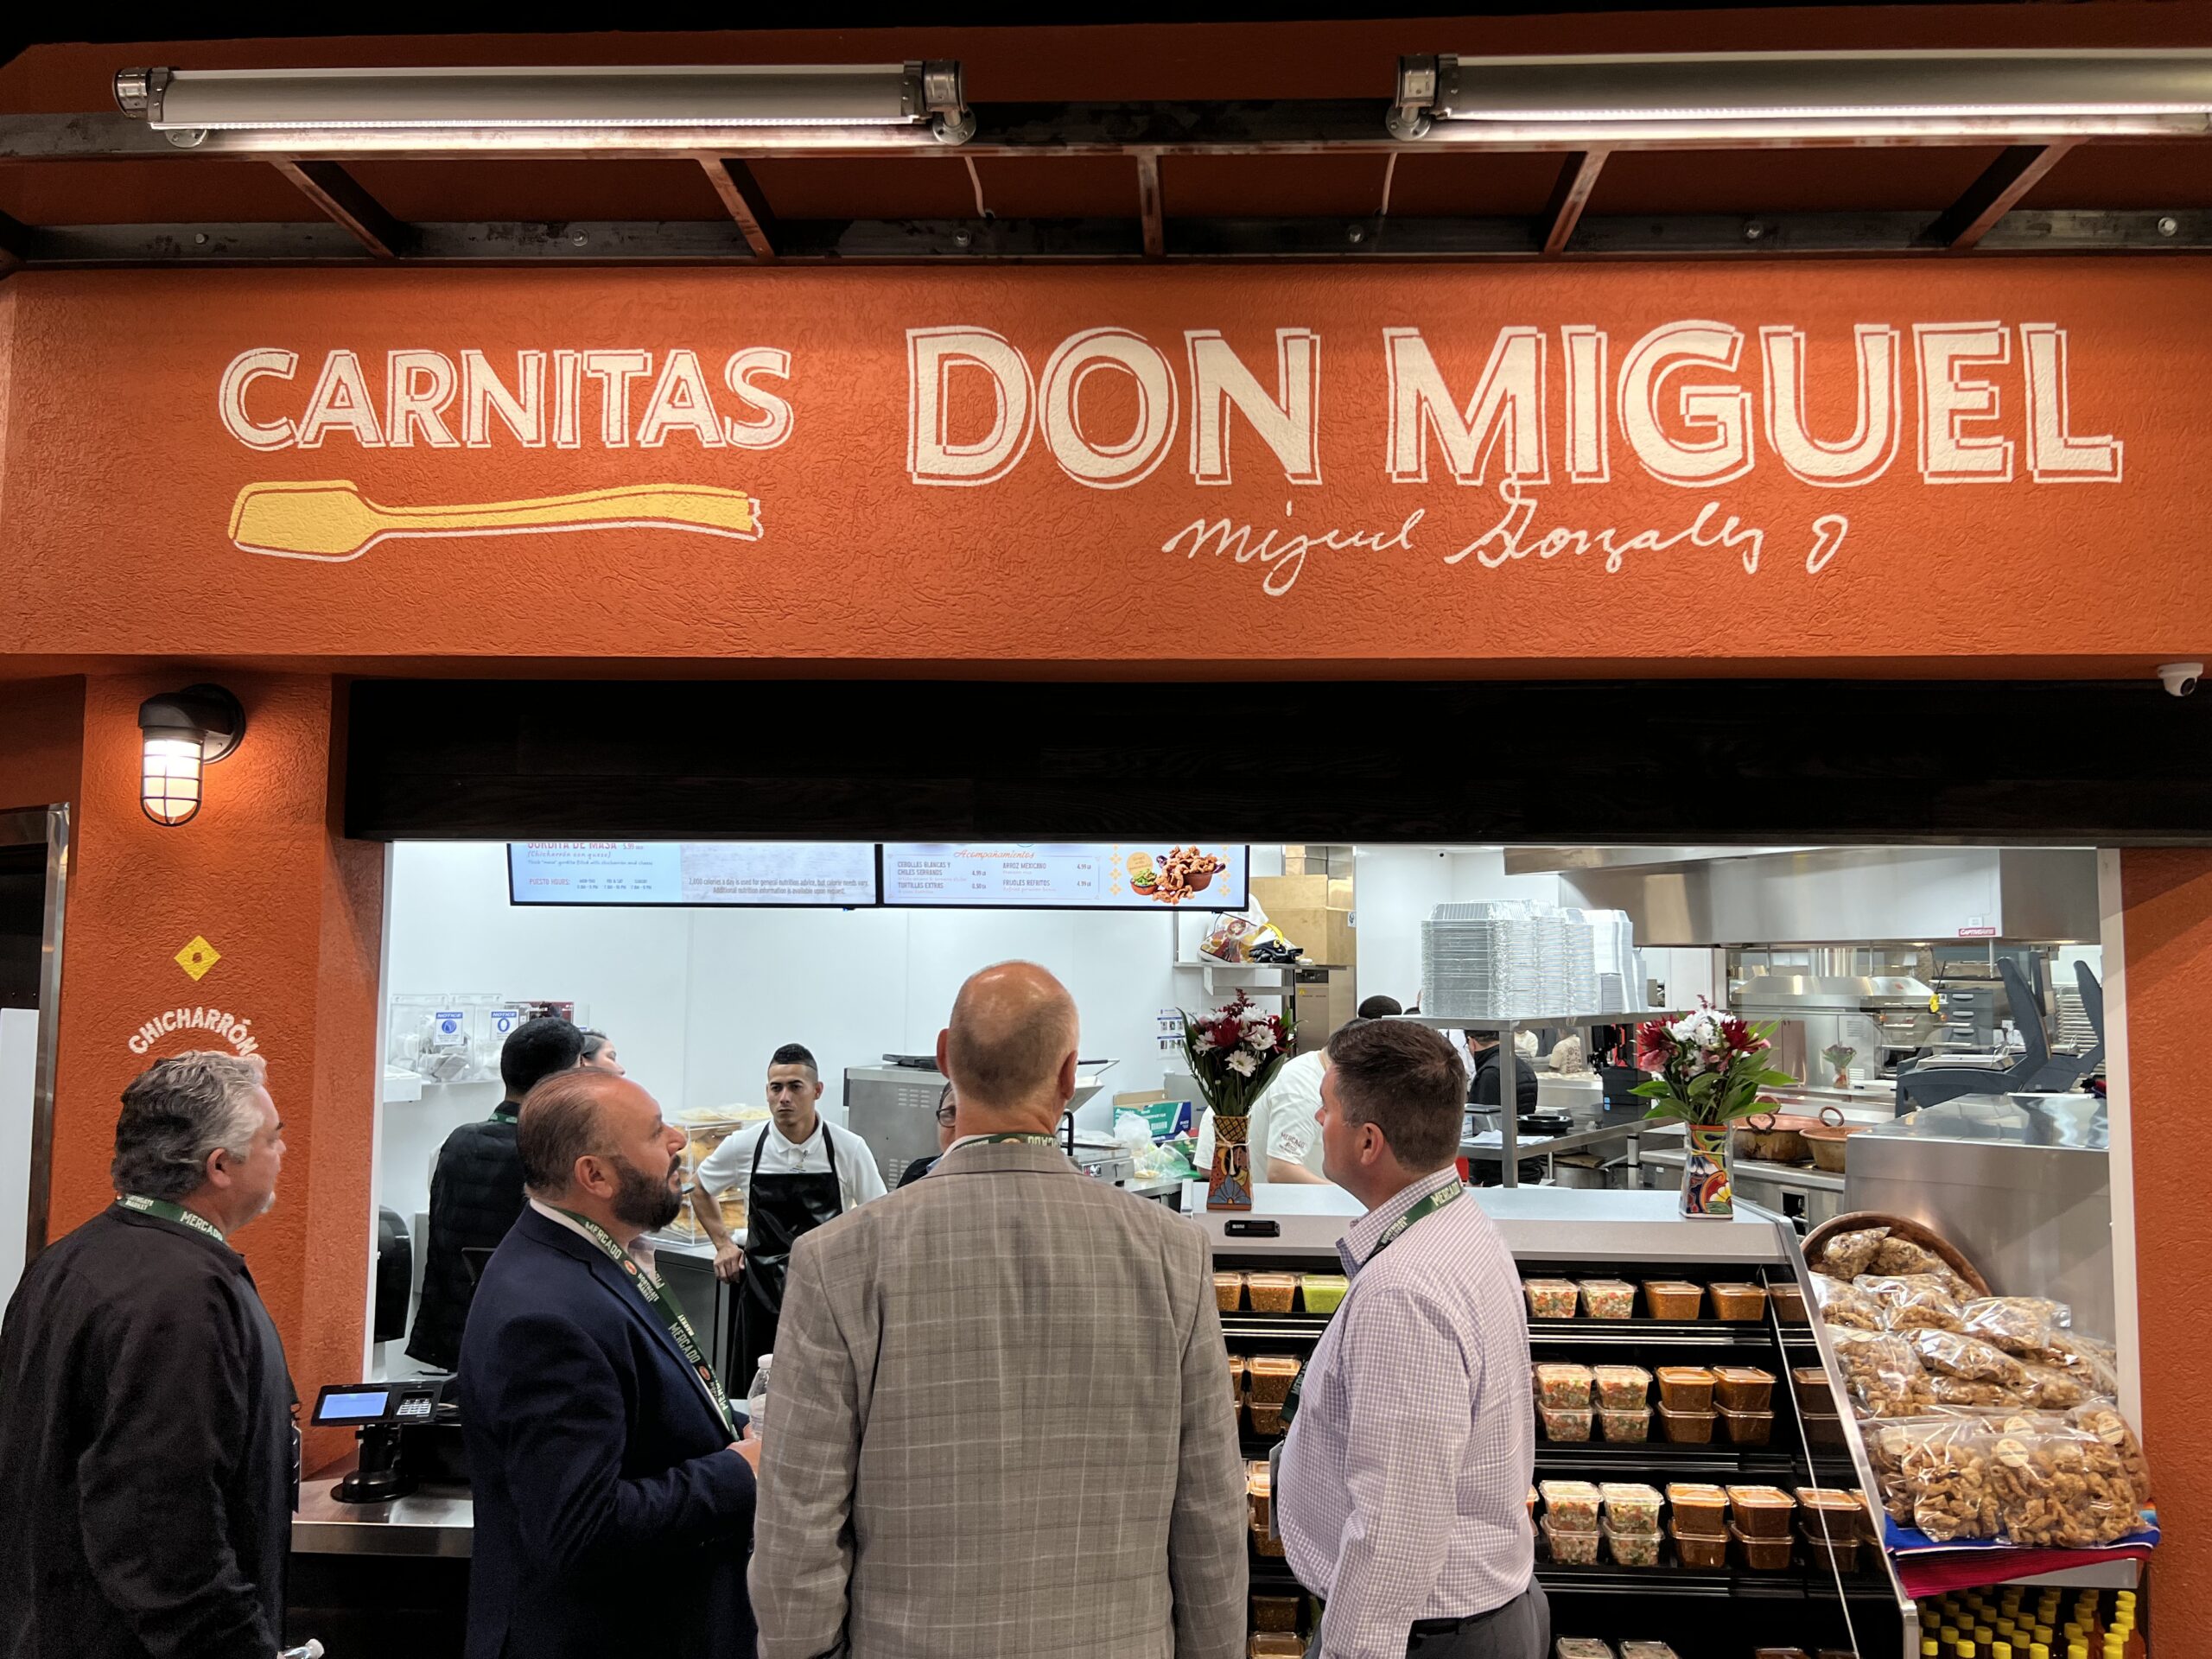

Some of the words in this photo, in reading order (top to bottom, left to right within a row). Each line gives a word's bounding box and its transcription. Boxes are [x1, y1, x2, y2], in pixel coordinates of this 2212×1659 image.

[219, 346, 795, 451] CARNITAS
[906, 325, 1323, 490] DON
[1382, 320, 2124, 488] MIGUEL
[954, 849, 1034, 861] Acompañamientos
[1430, 1181, 1461, 1206] MERCADO
[180, 1211, 223, 1241] MERCADO
[585, 1221, 623, 1260] MERCADO
[1381, 1215, 1408, 1244] NORTHGATE
[637, 1272, 660, 1302] NORTHGATE
[668, 1322, 701, 1363] MERCADO
